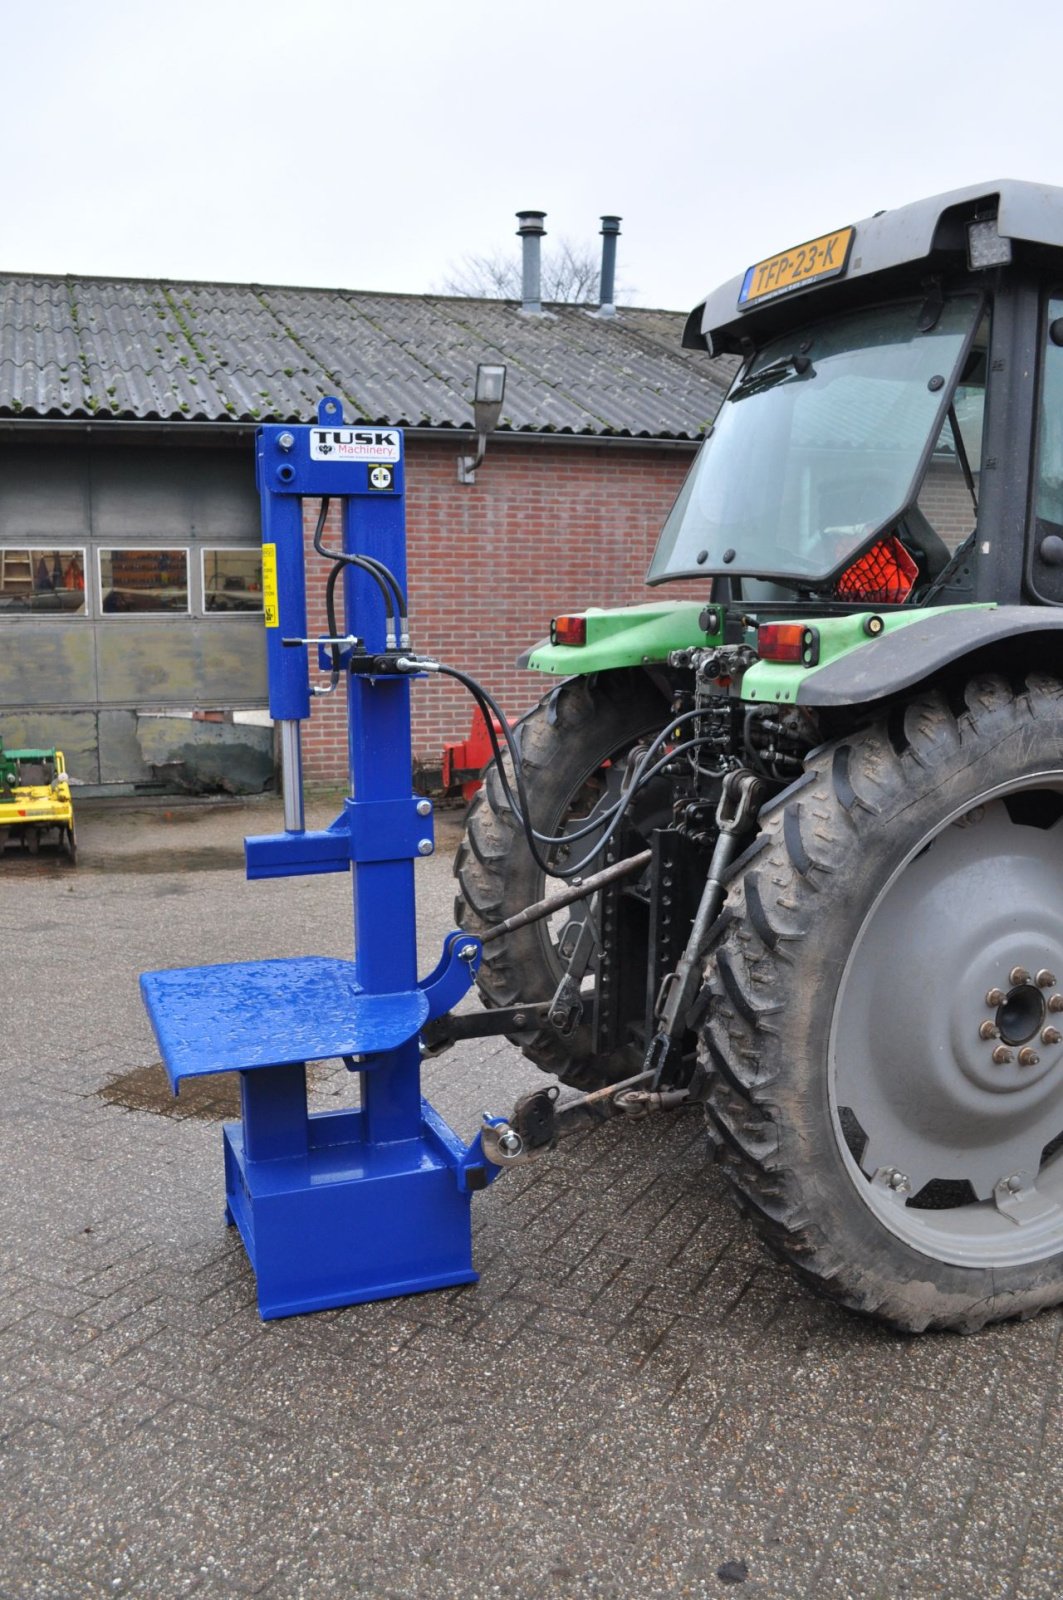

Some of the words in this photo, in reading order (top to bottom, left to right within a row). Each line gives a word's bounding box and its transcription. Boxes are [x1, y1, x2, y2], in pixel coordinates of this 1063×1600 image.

[757, 237, 839, 291] TFP-23-K
[313, 431, 396, 446] TUSK
[338, 445, 394, 456] Machinery
